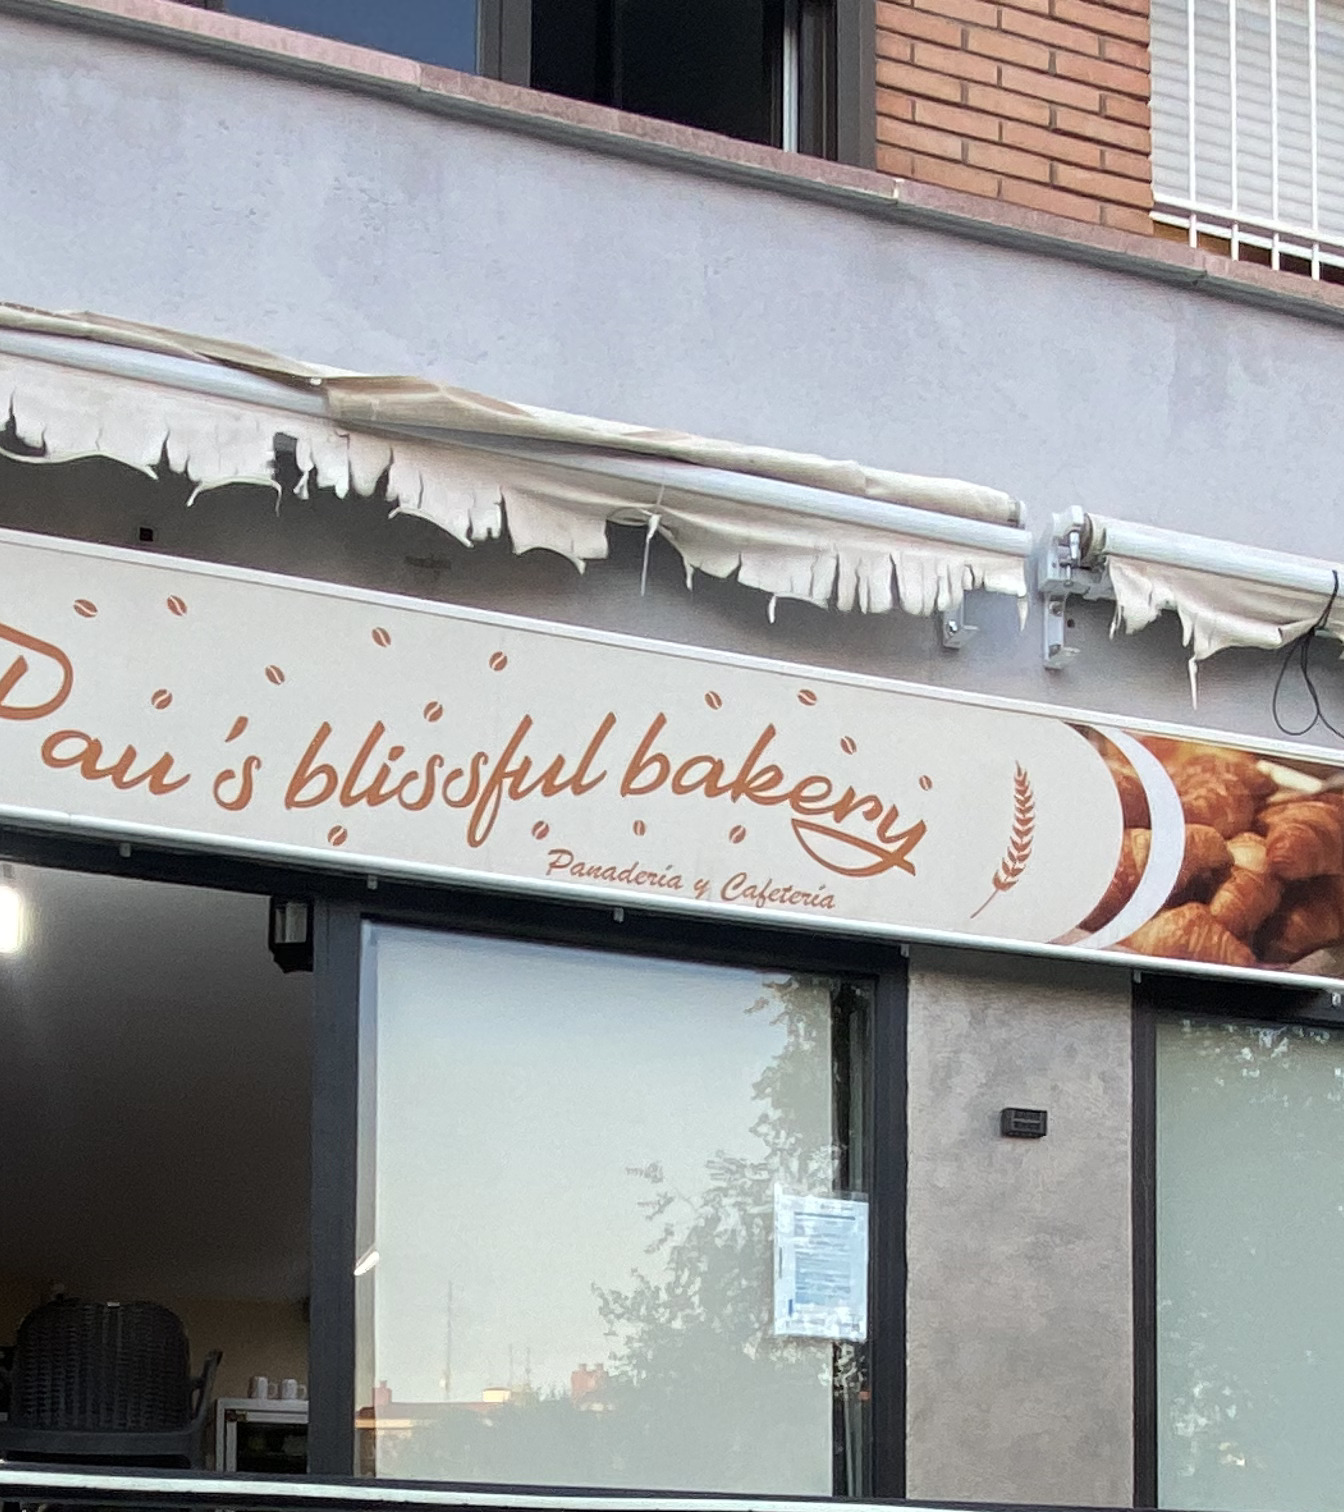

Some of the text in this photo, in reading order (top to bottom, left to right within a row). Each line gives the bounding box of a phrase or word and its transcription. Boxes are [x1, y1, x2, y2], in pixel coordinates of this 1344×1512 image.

[283, 709, 618, 848] blissful
[619, 711, 929, 879] bakery
[545, 847, 836, 910] Panadería y Cafetería
